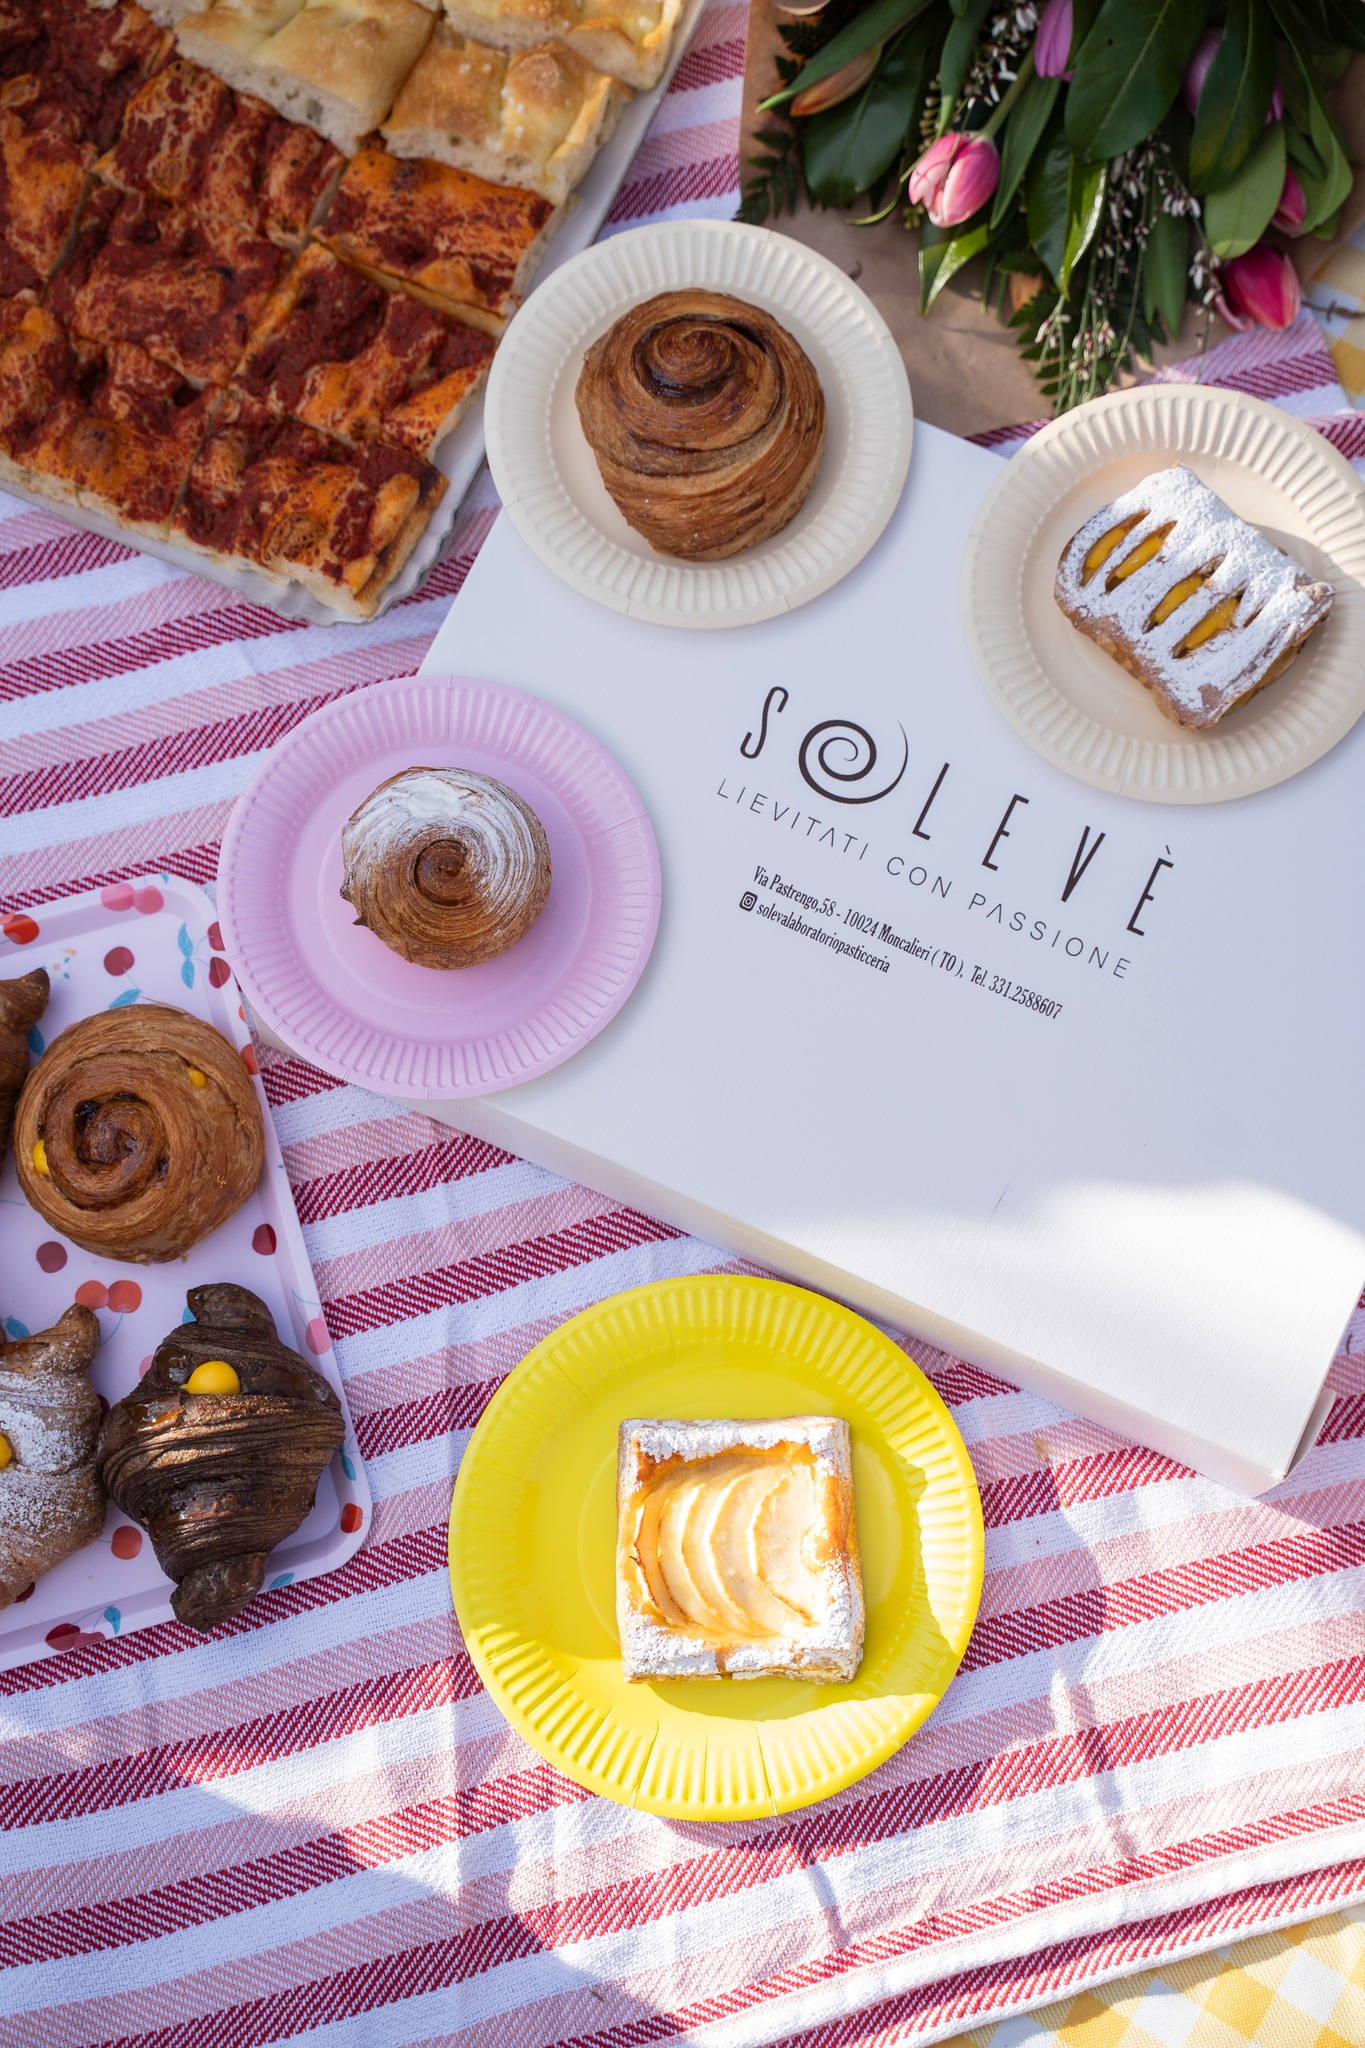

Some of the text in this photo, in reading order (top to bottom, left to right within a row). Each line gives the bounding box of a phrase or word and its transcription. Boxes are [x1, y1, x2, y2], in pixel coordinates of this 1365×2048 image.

[717, 779, 1131, 978] LIEVITATI CON PASSIONE
[740, 686, 1174, 936] SOLEVÈ
[752, 866, 770, 888] Via
[843, 909, 879, 937] 10024
[876, 923, 932, 962] Moncalieri
[969, 965, 988, 988] Tel.
[988, 974, 1063, 1019] 331.2588607
[757, 903, 891, 973] solevalaboratoriopasticceria
